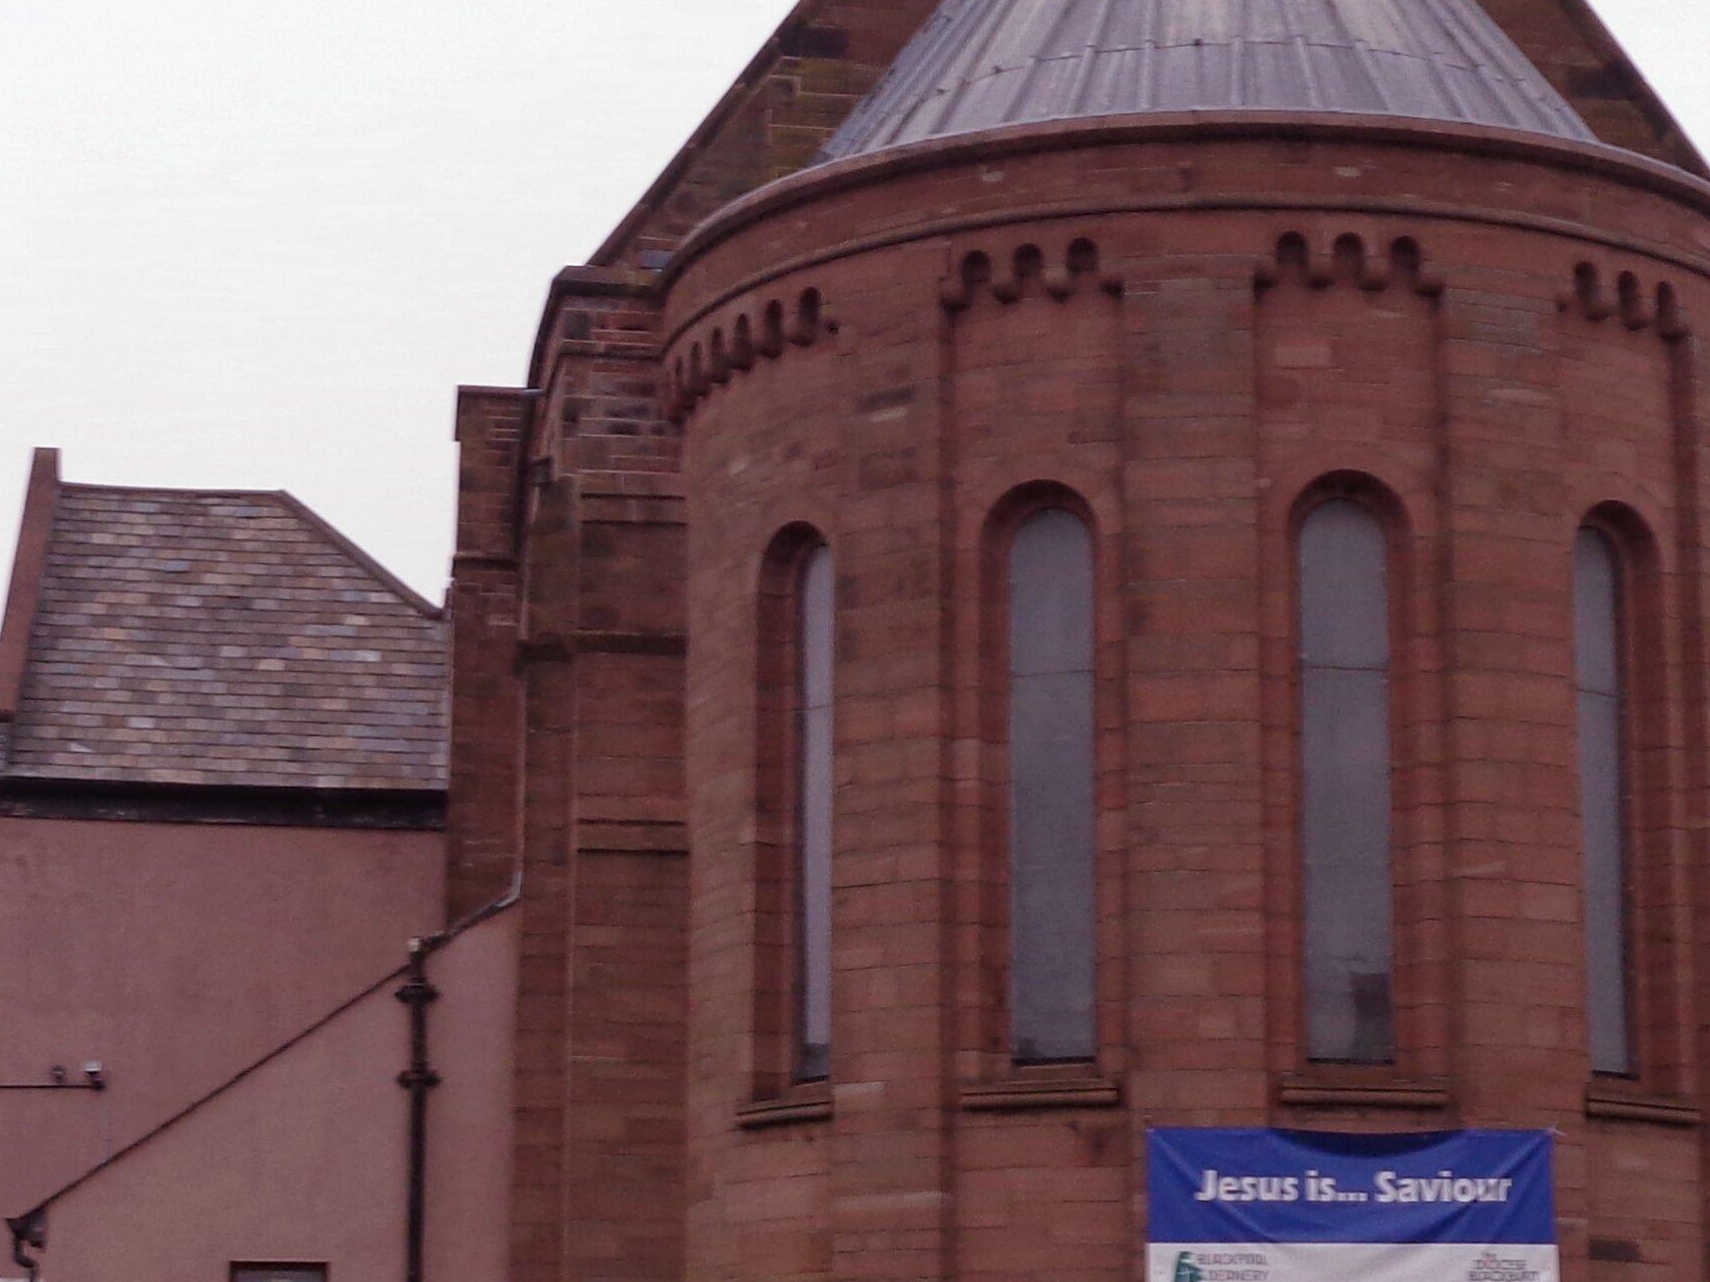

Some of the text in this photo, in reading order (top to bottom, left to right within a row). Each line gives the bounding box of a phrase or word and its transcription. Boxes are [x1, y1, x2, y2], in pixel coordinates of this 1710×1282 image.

[1195, 1169, 1513, 1204] Jesus is... Saviour
